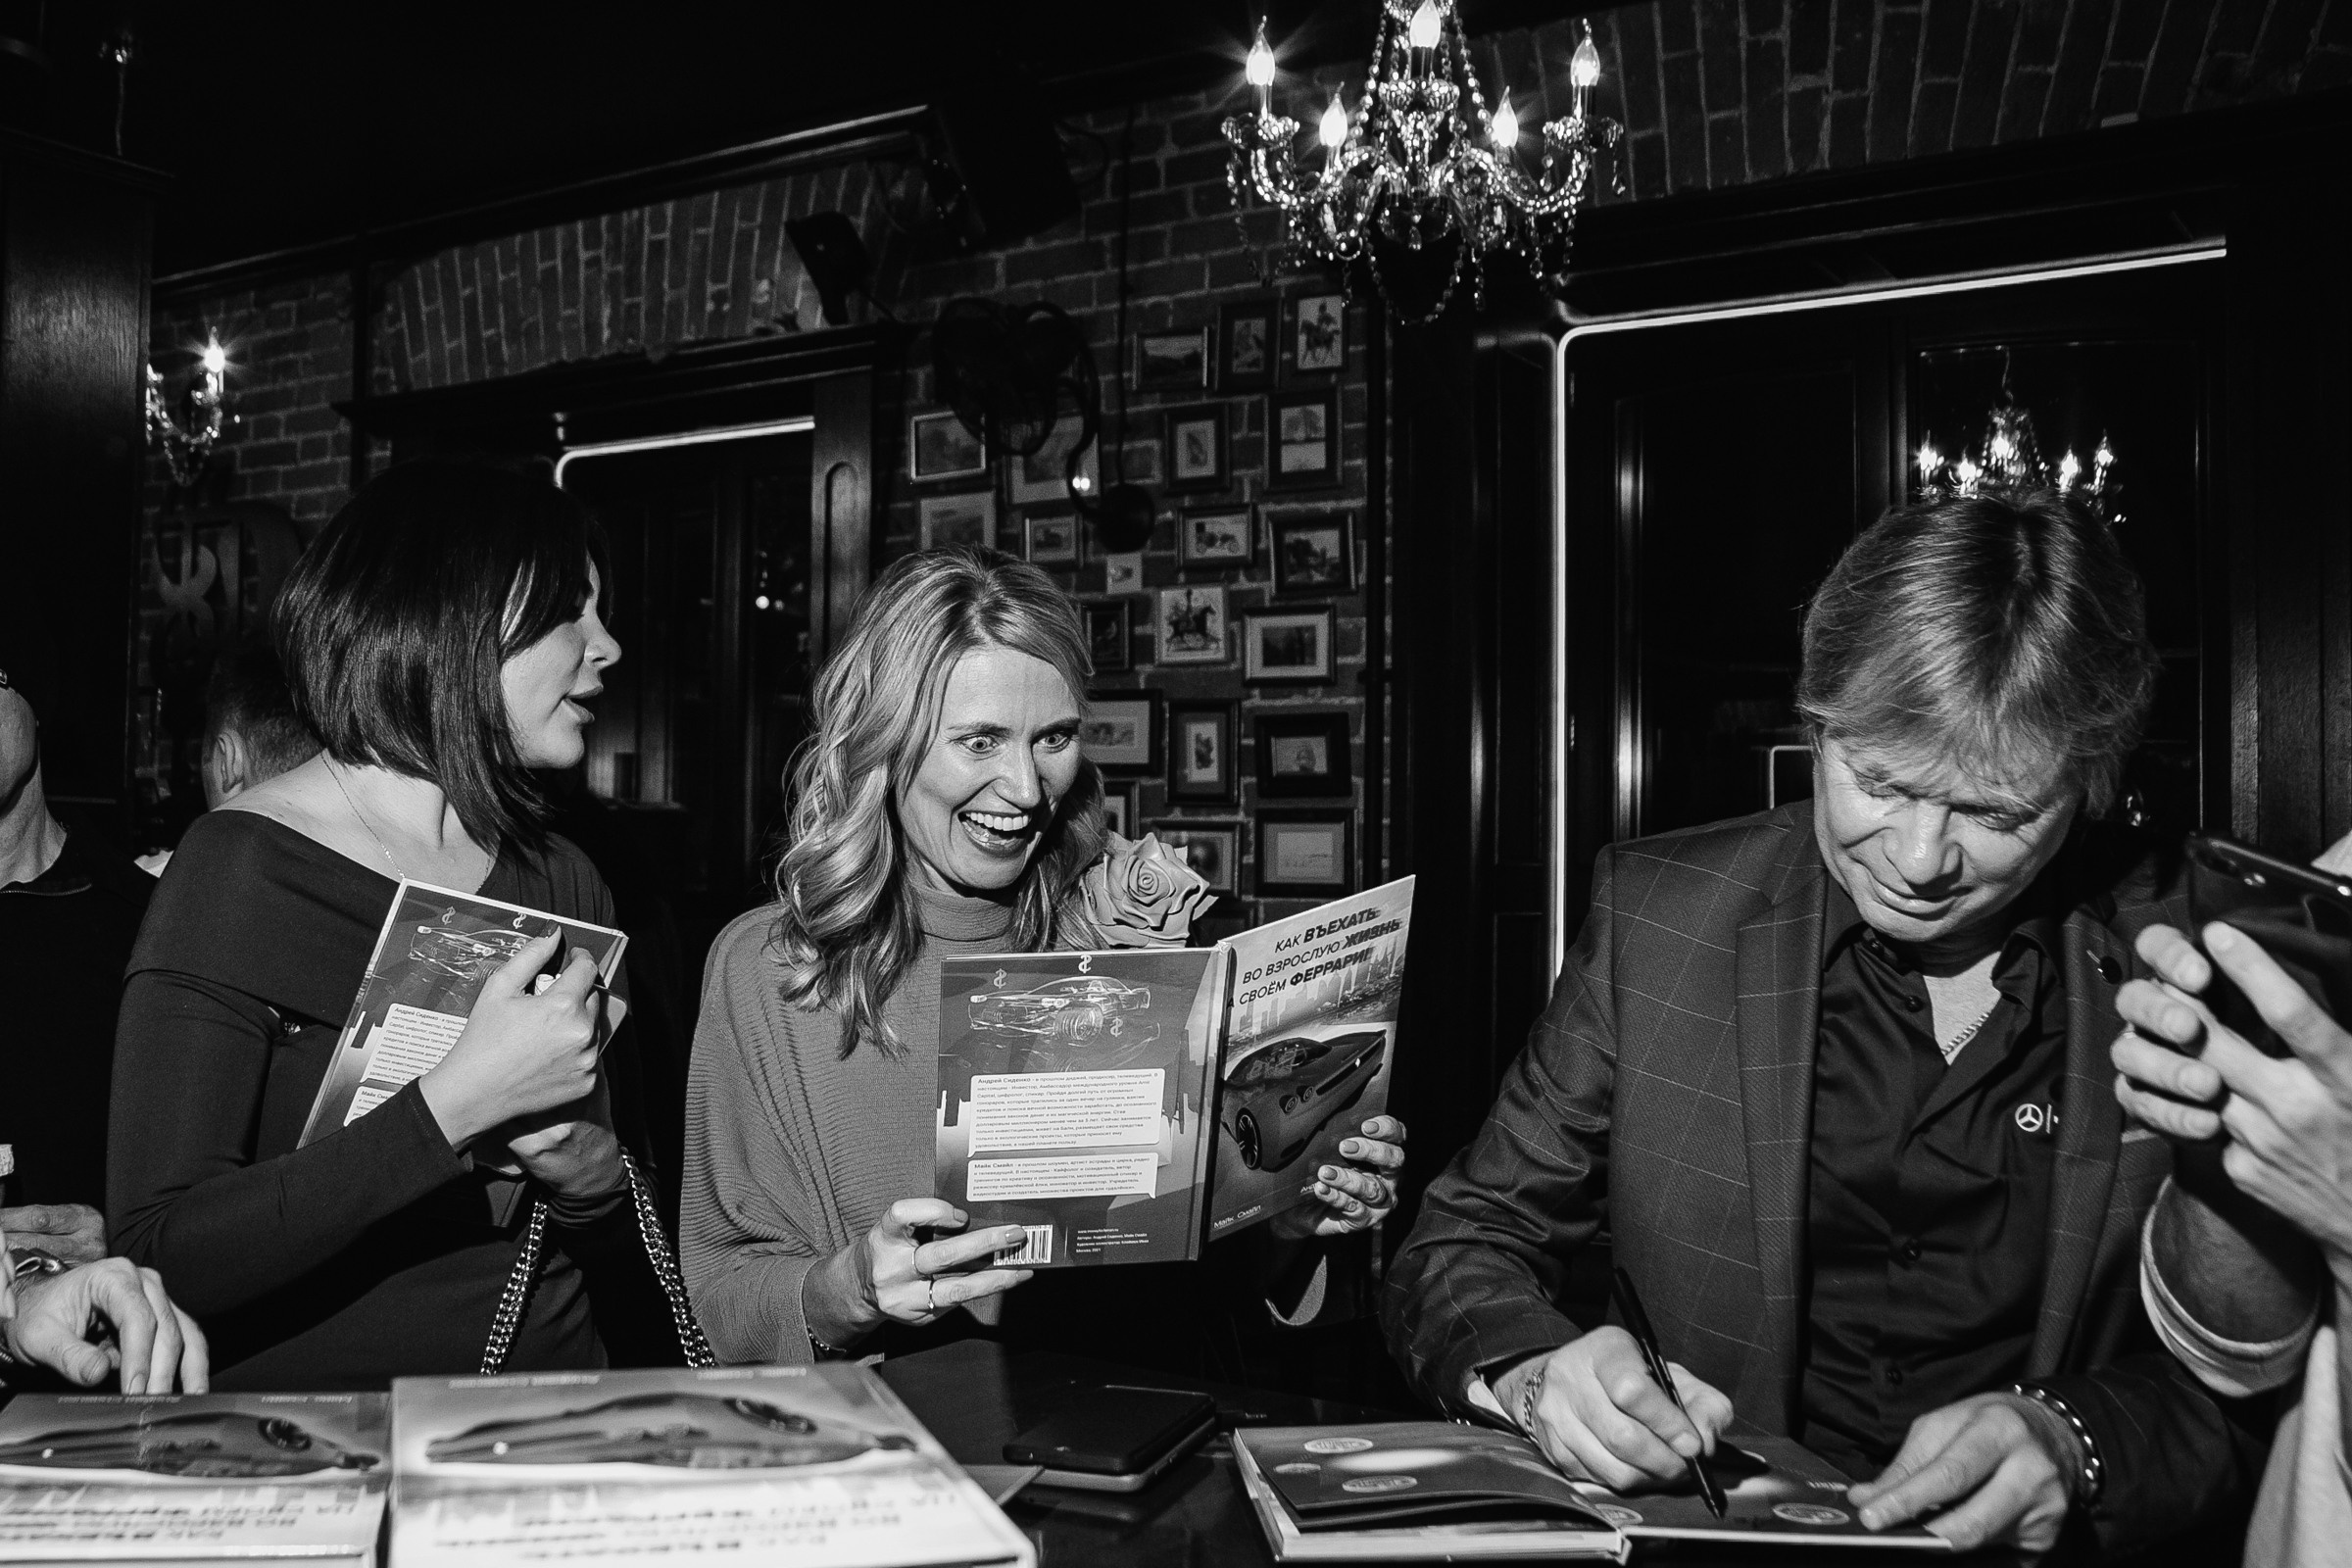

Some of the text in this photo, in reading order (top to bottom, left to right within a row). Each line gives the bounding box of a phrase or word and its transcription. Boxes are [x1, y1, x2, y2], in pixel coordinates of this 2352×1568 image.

[1274, 907, 1381, 953] КАК ВЪЕХАТЬ
[1242, 918, 1402, 984] ВО ВЗРОСЛУЮ ЖИЗНЬ
[1239, 978, 1286, 1004] СВОЁМ
[416, 1012, 439, 1021] Сиденко
[1214, 1205, 1261, 1228] Майк Смайл
